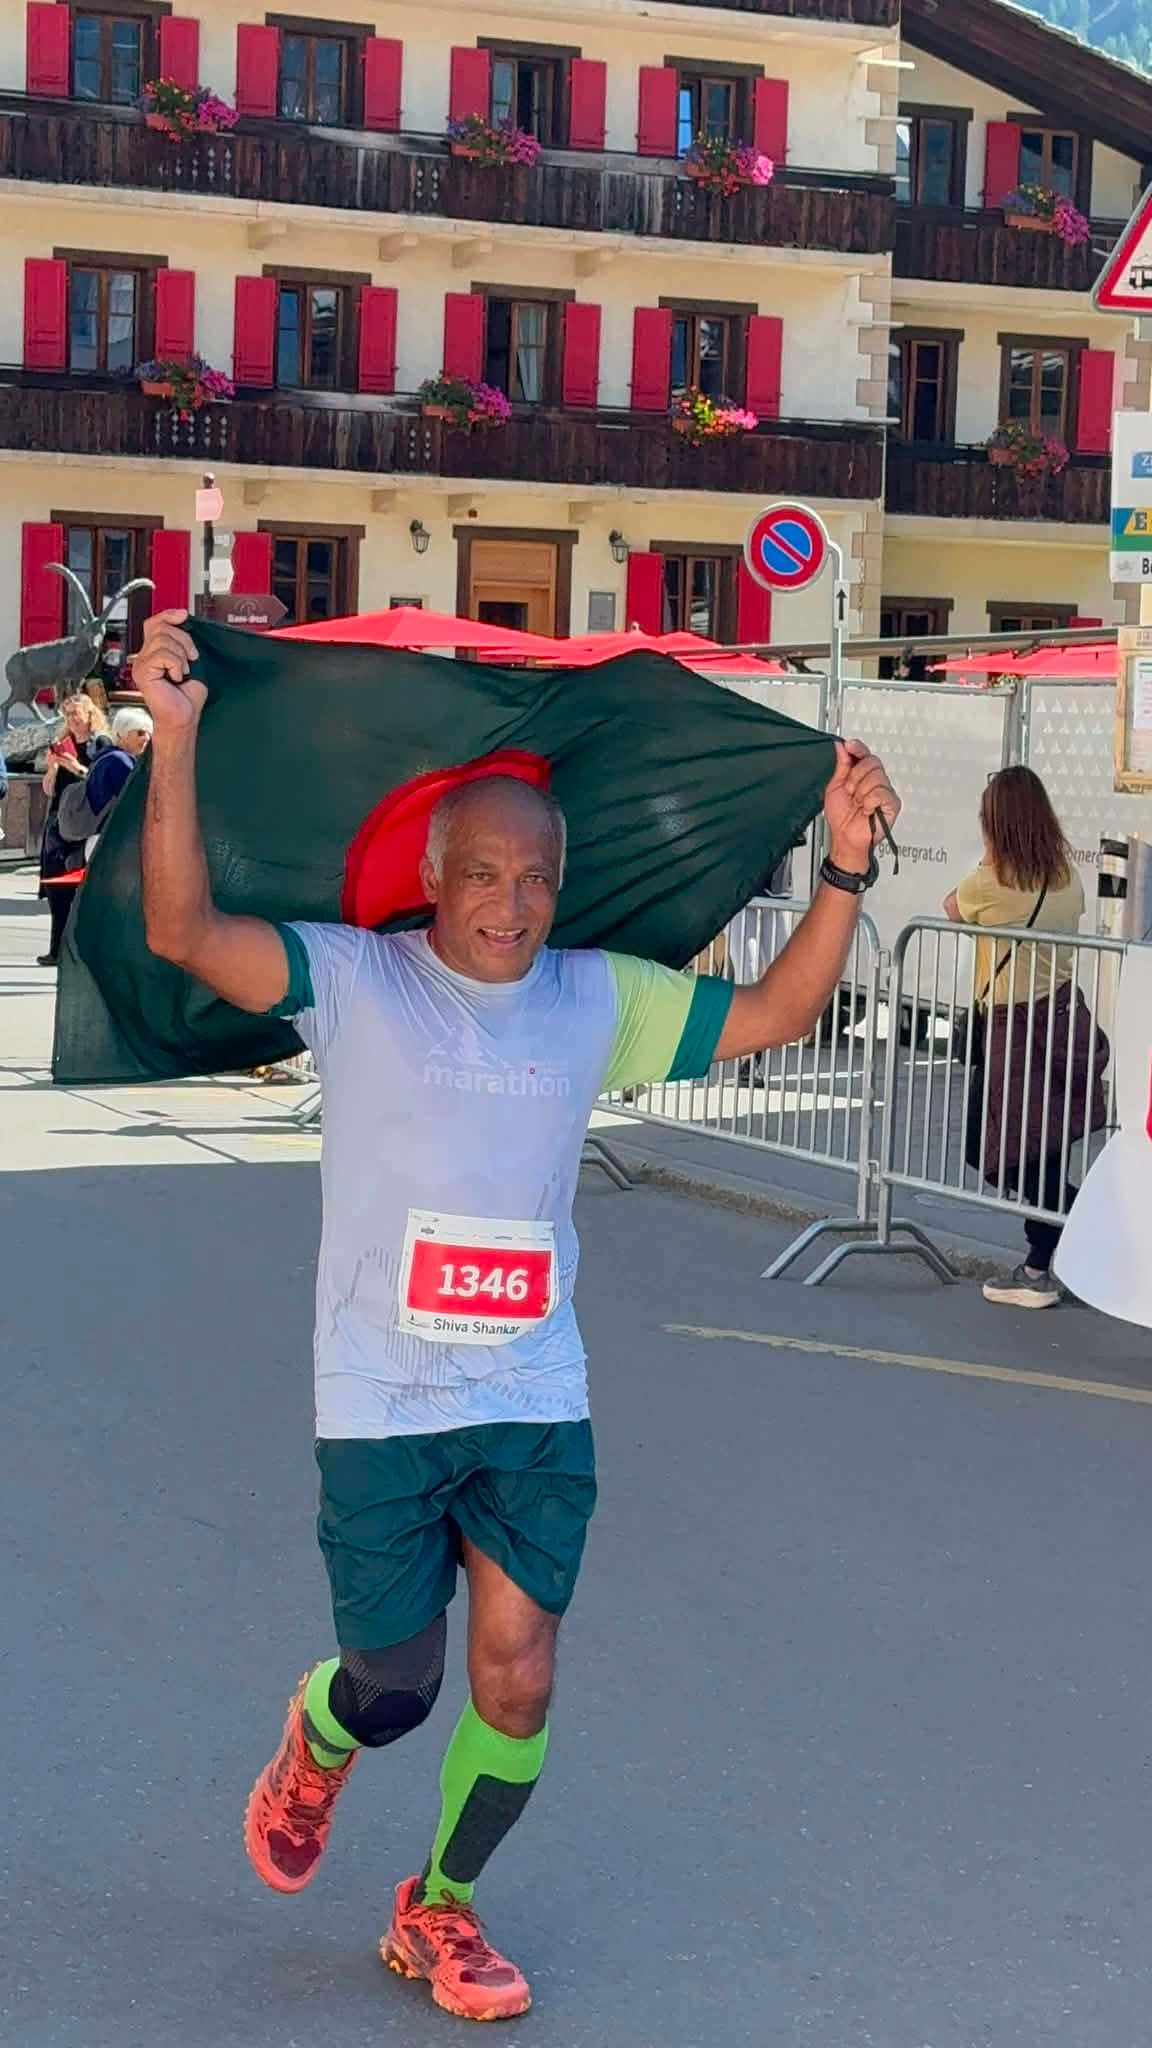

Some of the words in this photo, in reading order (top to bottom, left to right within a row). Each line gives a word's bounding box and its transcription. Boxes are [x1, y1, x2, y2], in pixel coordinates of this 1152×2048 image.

[879, 843, 947, 864] gonergrat.ch
[424, 1063, 571, 1097] marathon
[437, 1263, 529, 1301] 1346
[433, 1318, 468, 1332] Shiva
[472, 1321, 520, 1335] Shankar
